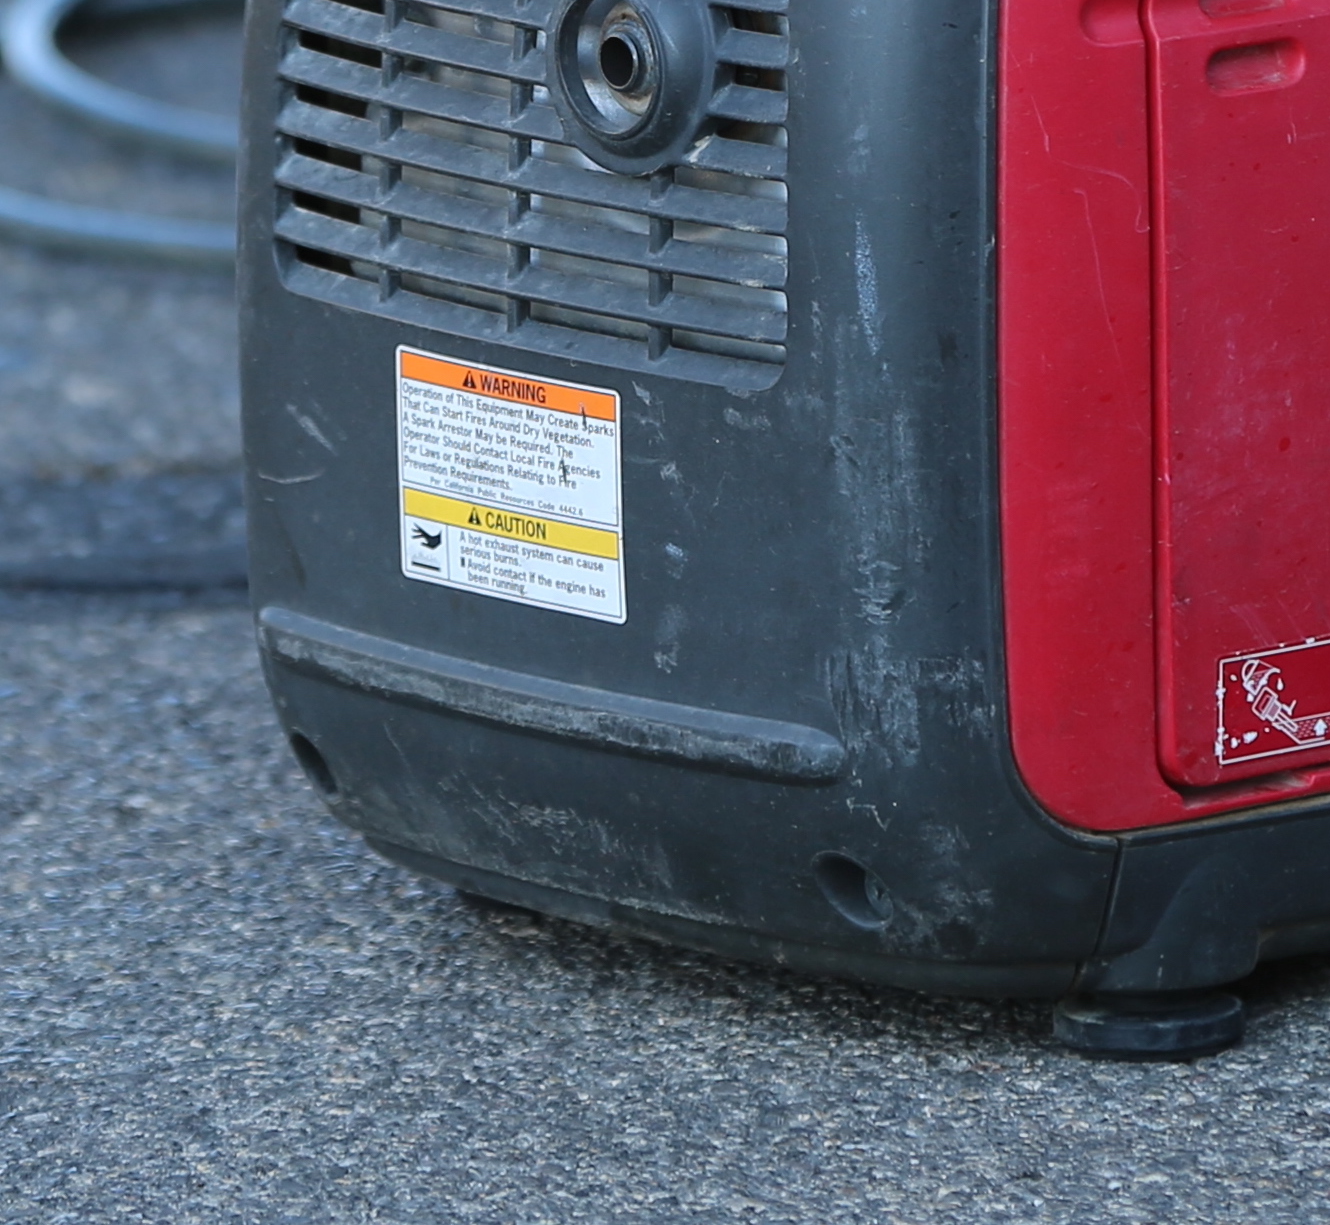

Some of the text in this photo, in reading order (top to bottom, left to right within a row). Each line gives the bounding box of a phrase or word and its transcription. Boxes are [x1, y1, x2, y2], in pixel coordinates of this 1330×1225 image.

[402, 382, 443, 403] Operation
[445, 393, 454, 405] of
[456, 393, 474, 412] This
[476, 398, 523, 419] Equipment
[525, 408, 545, 426] May
[547, 413, 578, 430] Create
[480, 375, 546, 403] WARNING
[401, 395, 421, 415] That
[422, 401, 440, 415] Can
[442, 405, 463, 421] Start
[465, 410, 487, 426] Fires
[488, 414, 521, 433] Around
[522, 423, 540, 440] Dry
[402, 411, 409, 429] A
[411, 413, 435, 429] Spark
[438, 421, 472, 437] Arrestor
[475, 428, 493, 445] May
[495, 432, 507, 445] be
[556, 442, 573, 460] The
[403, 427, 440, 446] Operator
[442, 435, 471, 453] Should
[473, 442, 508, 461] Contact
[510, 450, 535, 466] Local
[537, 455, 555, 470] Fire
[403, 441, 576, 489] For Laws or Regulations Relating to Fire
[403, 458, 448, 476] Prevention
[485, 512, 546, 539] CAUTION
[459, 530, 604, 572] A hot exhaust system can cause
[460, 545, 491, 560] serious
[467, 570, 489, 585] been
[467, 558, 606, 598] Avoid contact if the engine has
